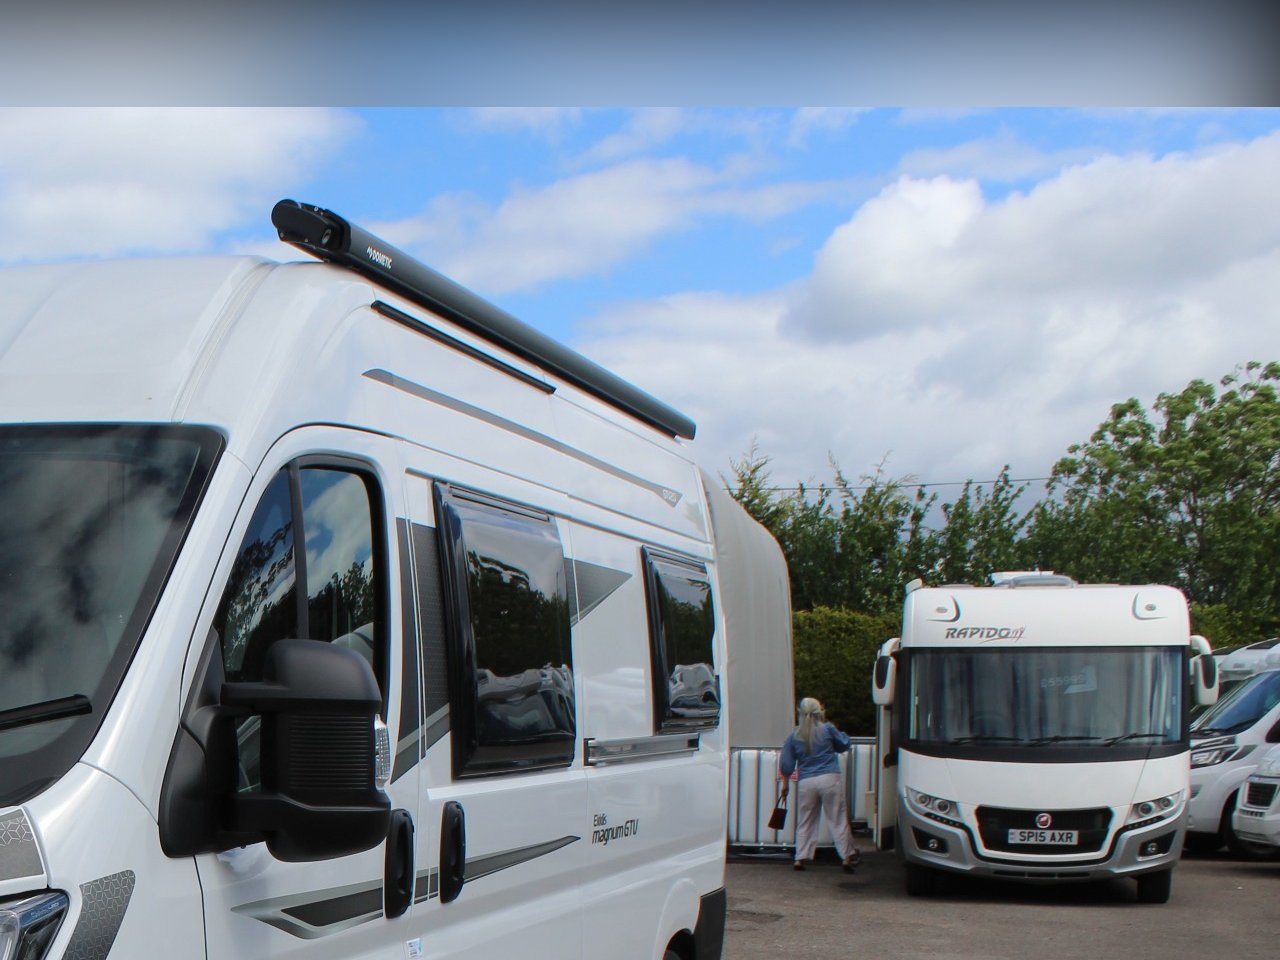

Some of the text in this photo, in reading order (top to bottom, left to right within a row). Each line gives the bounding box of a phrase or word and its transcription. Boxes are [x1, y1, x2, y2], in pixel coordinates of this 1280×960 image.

[372, 248, 393, 270] DOMETIC
[944, 626, 1012, 639] RAPIDO
[1018, 831, 1073, 842] SP15 AXR
